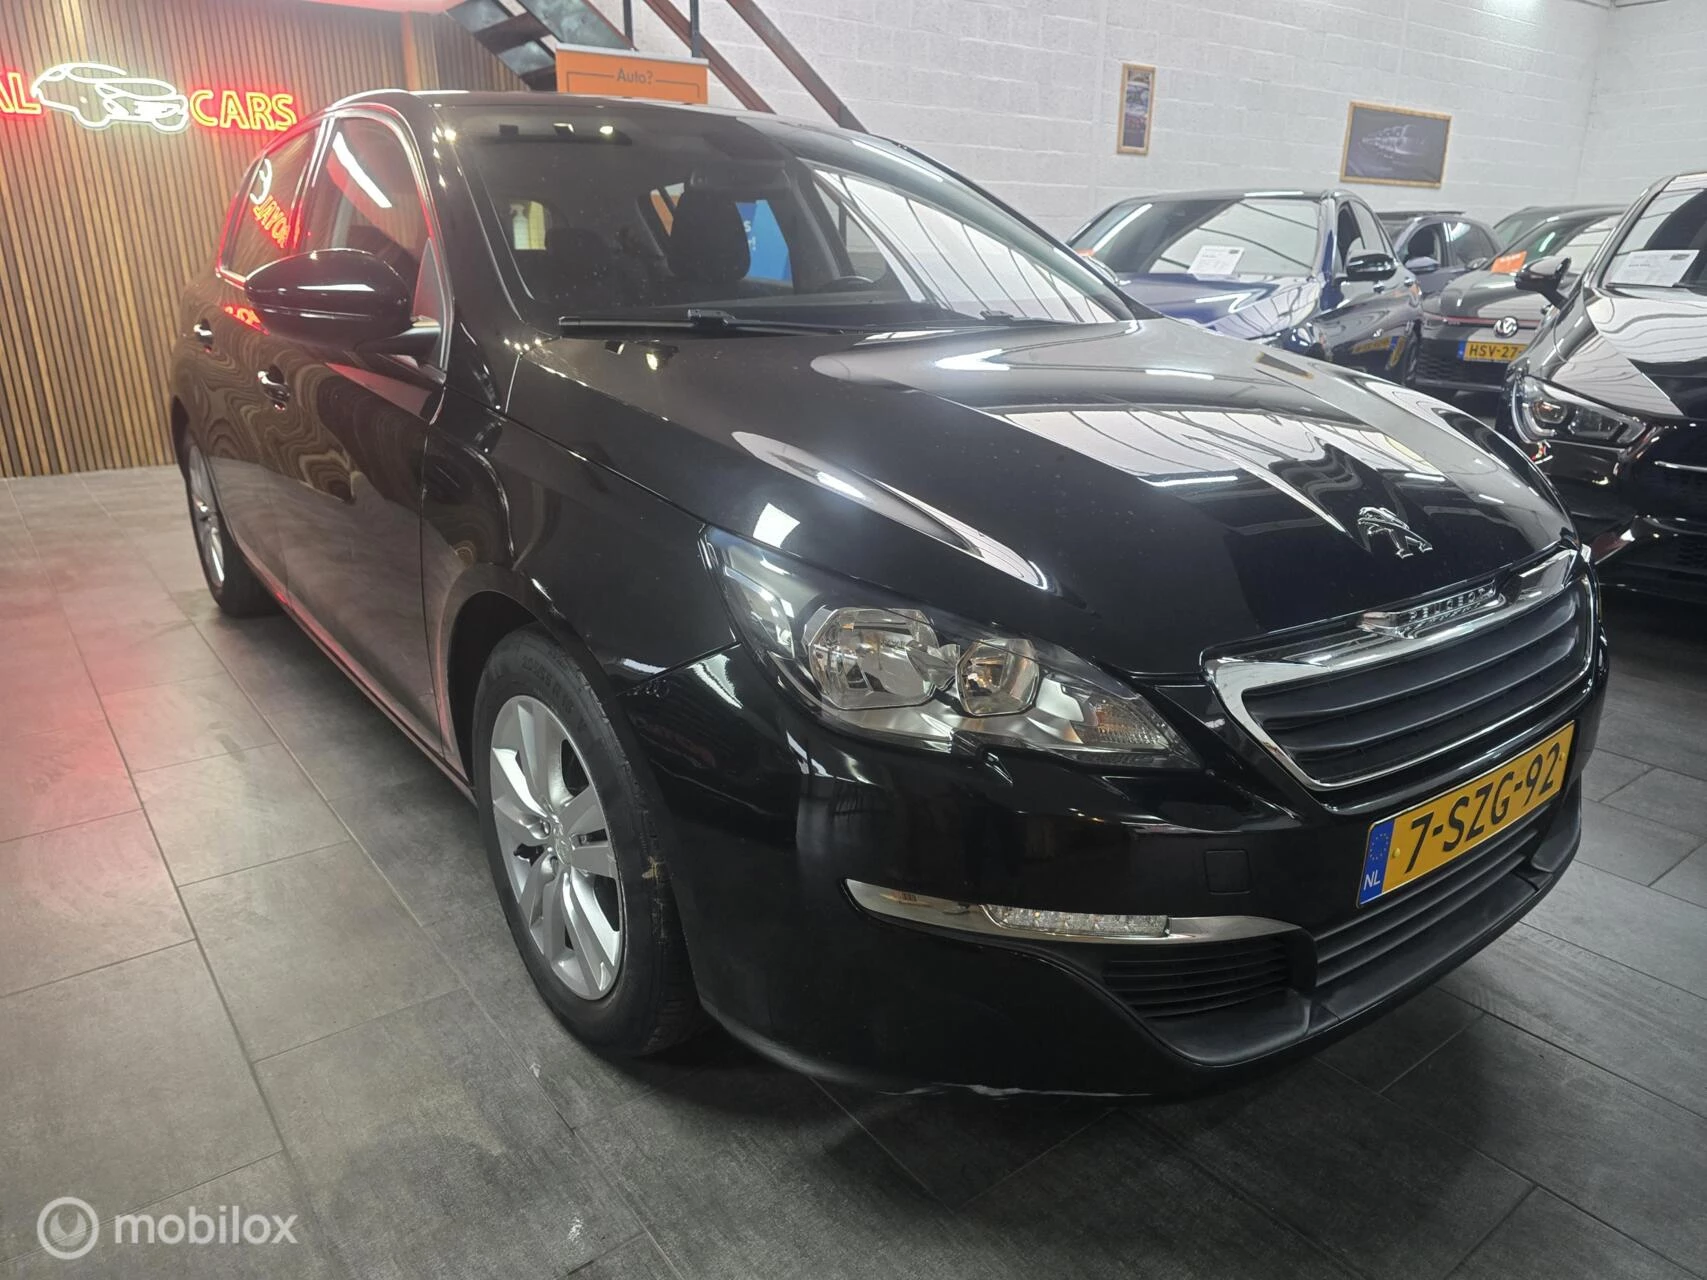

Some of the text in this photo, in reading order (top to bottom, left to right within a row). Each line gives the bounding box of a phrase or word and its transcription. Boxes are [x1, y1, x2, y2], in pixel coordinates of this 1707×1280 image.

[616, 67, 654, 85] Auto?
[189, 89, 298, 131] CARS
[1404, 741, 1561, 874] 7-SZG-92
[1362, 872, 1381, 891] NL
